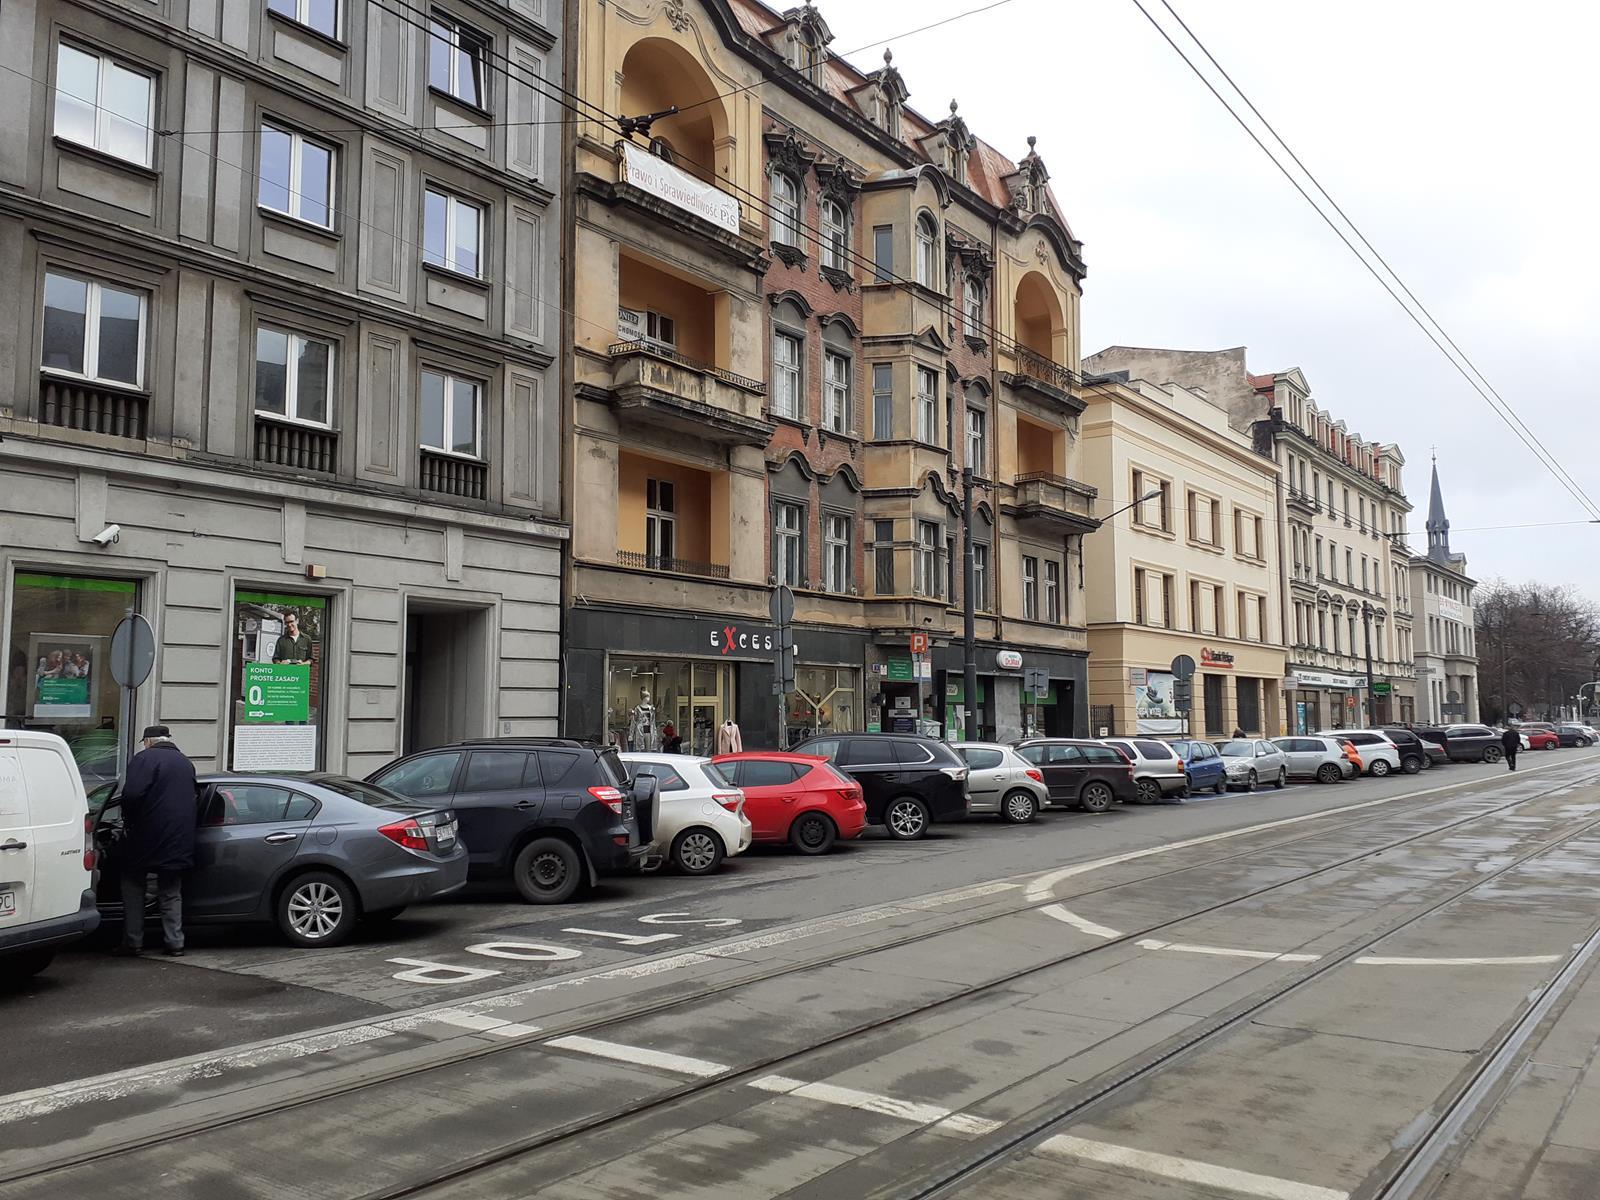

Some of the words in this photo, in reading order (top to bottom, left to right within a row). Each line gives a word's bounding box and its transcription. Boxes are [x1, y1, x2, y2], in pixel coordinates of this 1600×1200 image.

[660, 177, 718, 218] Sprawiedliwość
[720, 208, 737, 228] PiS
[275, 675, 300, 683] ZASADY
